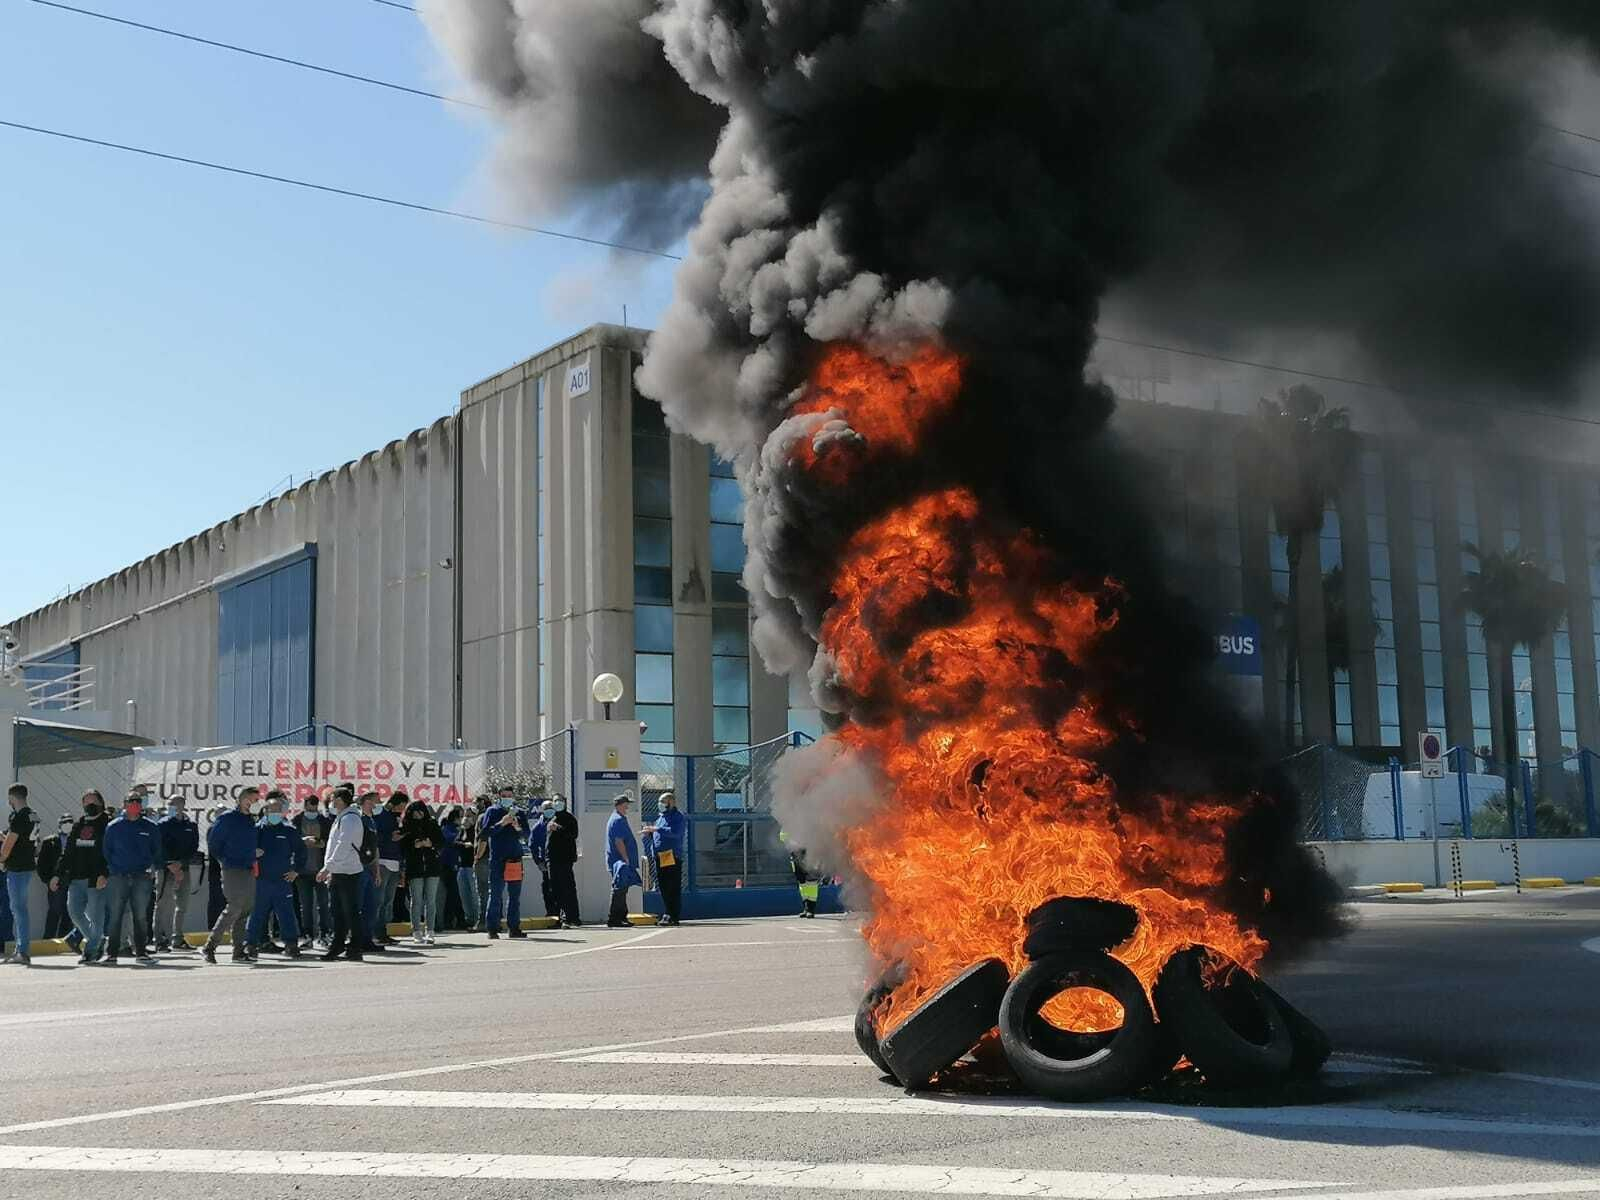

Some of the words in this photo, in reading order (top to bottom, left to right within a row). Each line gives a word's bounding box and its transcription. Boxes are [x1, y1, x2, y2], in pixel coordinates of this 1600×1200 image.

[570, 370, 589, 392] A01
[1214, 635, 1254, 655] BUS
[178, 759, 231, 777] POR
[241, 759, 270, 777] EL
[274, 758, 395, 780] EMPLEO
[401, 761, 416, 778] Y
[423, 761, 450, 778] EL
